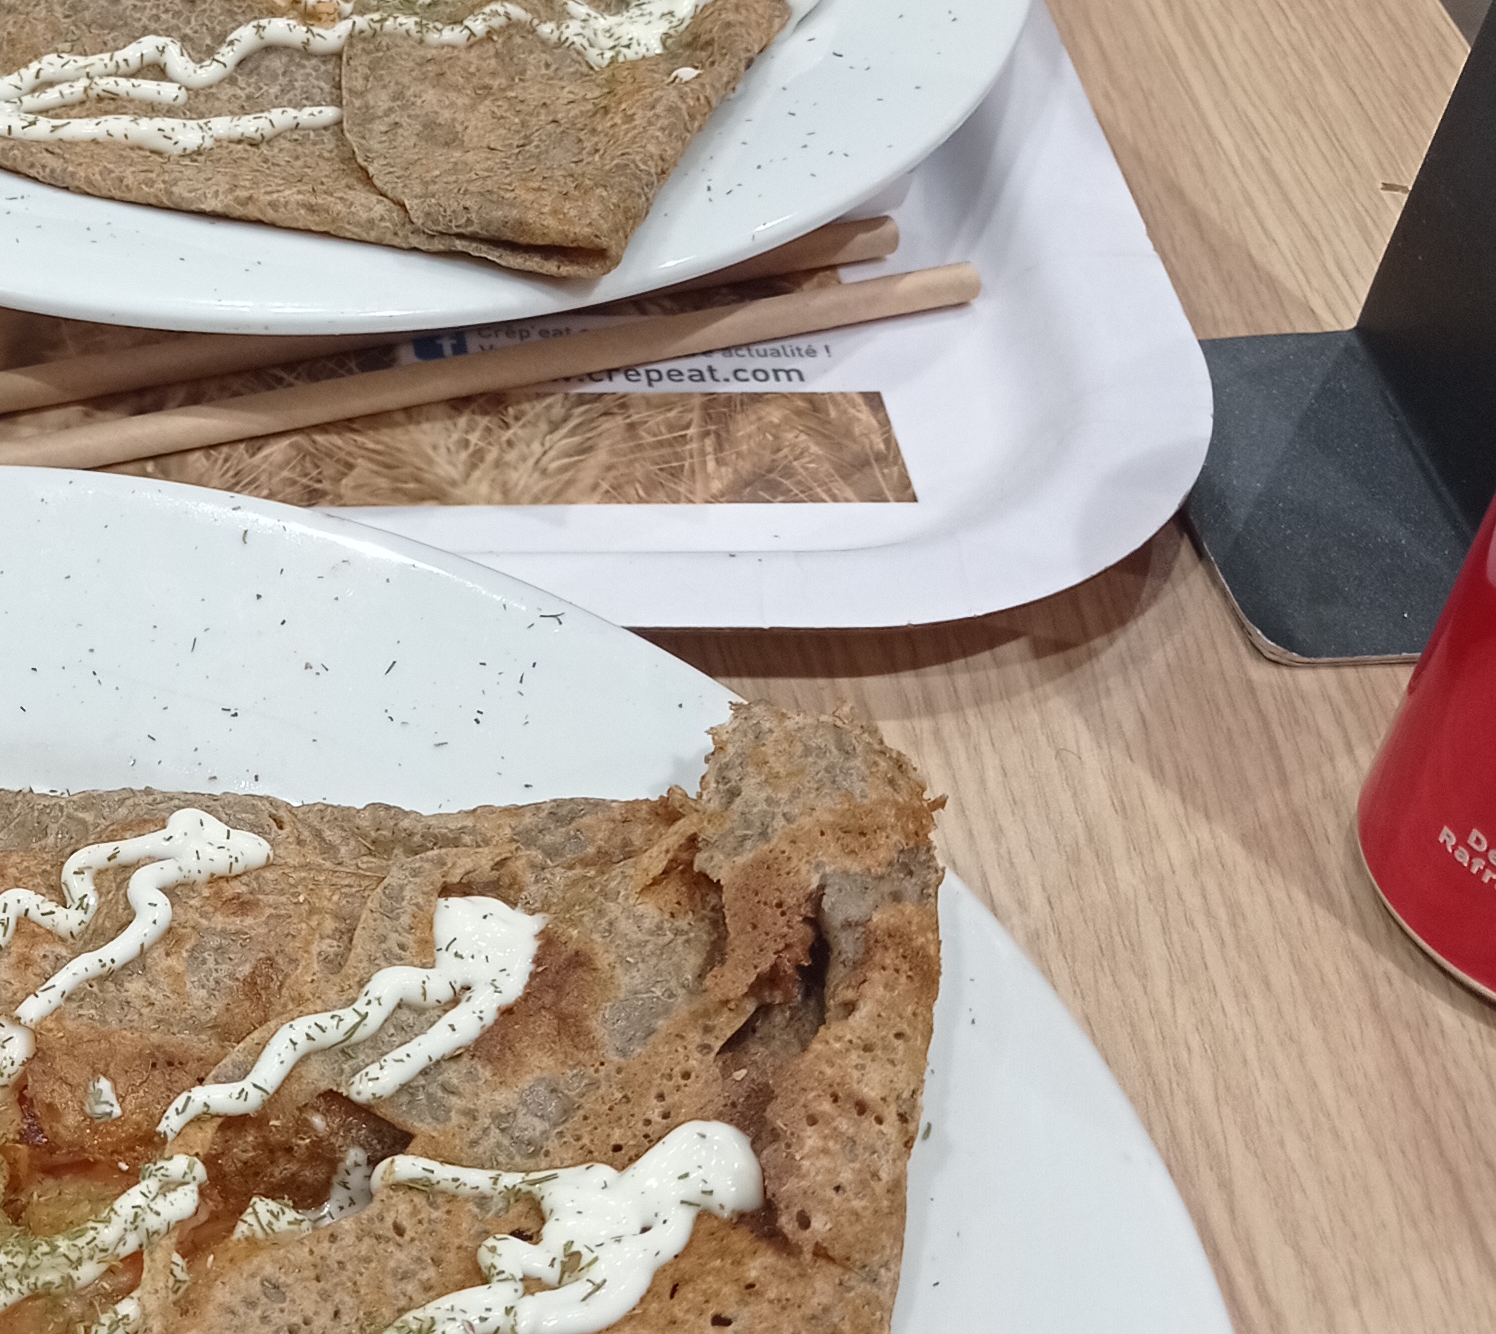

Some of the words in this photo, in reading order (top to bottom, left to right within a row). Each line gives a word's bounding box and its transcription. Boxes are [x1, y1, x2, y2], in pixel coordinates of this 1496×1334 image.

[721, 344, 818, 358] actualité
[554, 364, 805, 388] .crepeat.com
[1438, 825, 1496, 889] Rafr
